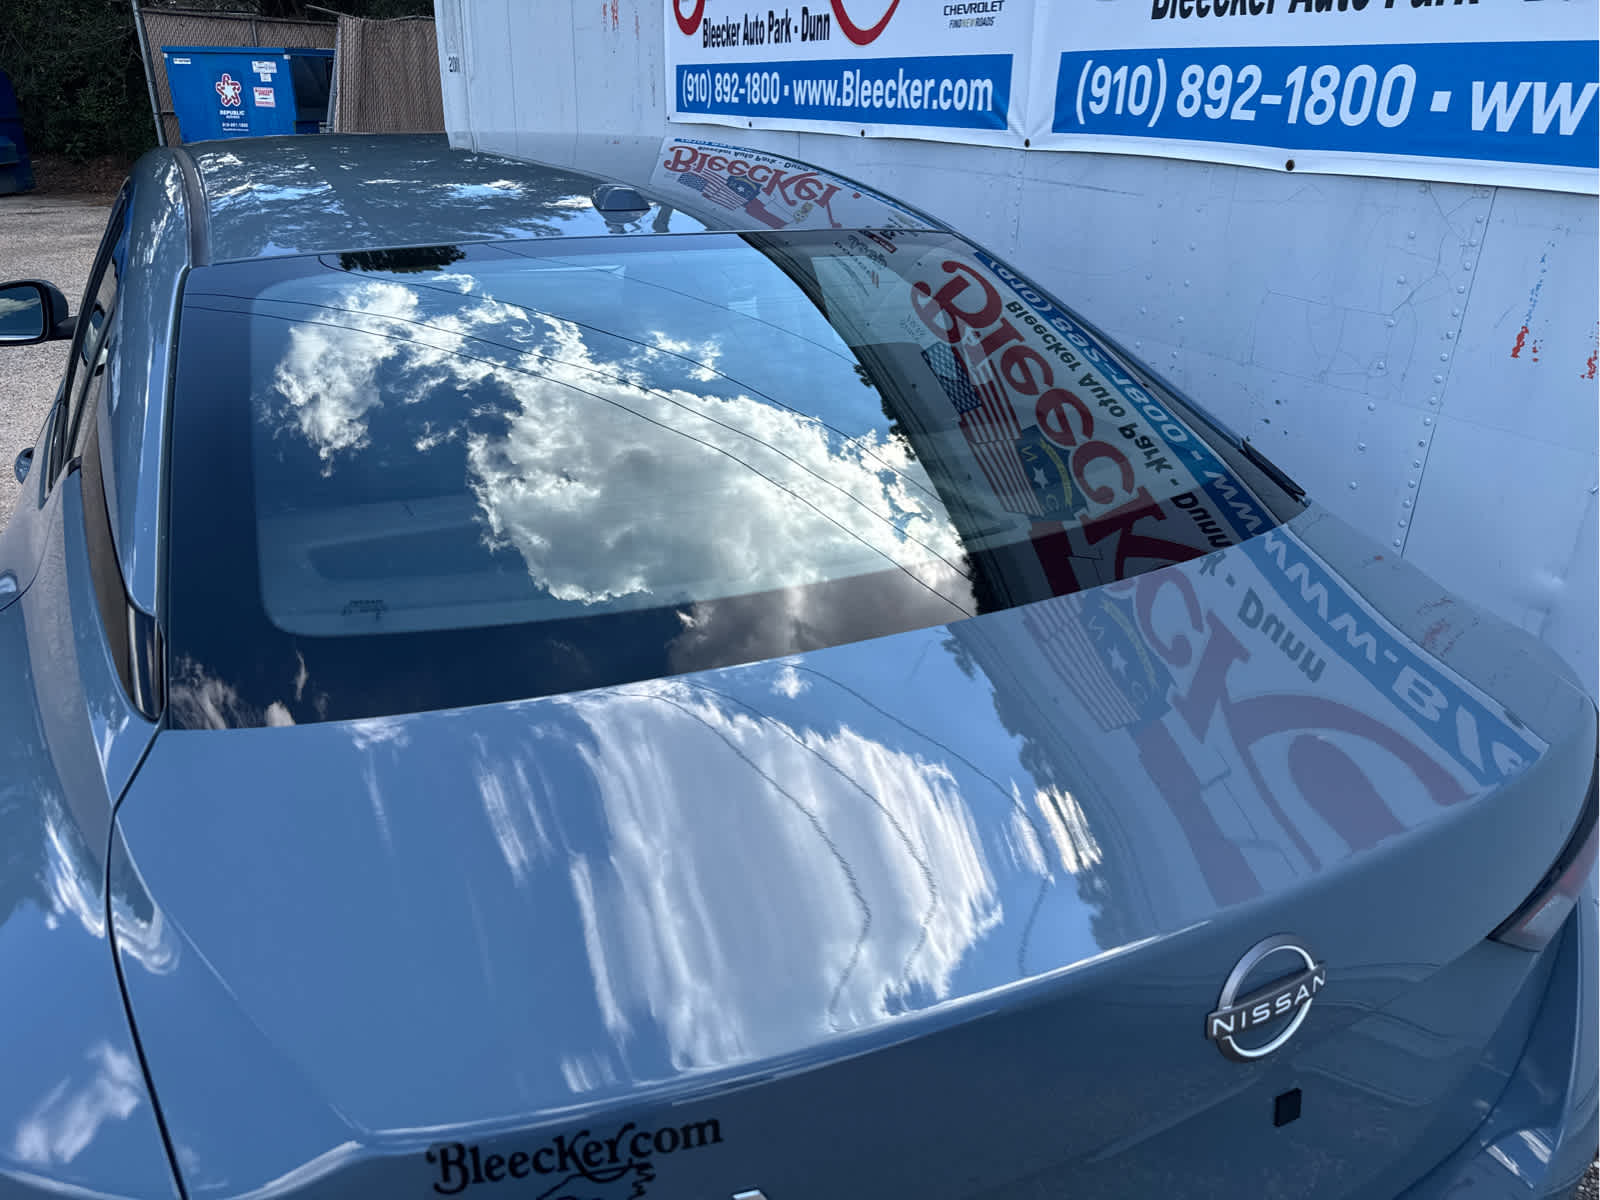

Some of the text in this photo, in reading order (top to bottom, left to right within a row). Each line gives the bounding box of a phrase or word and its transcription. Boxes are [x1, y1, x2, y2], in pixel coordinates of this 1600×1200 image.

[703, 16, 741, 48] Bleecker
[743, 13, 765, 46] Auto
[768, 8, 792, 44] Park
[801, 6, 830, 42] Dunn
[944, 0, 1005, 16] CHEVROLET
[682, 67, 993, 111] (910) 892-1800 www.Bleecker.com
[1075, 58, 1167, 128] (910)
[1176, 64, 1416, 128] 892-1800
[1212, 969, 1326, 1036] NISSAN
